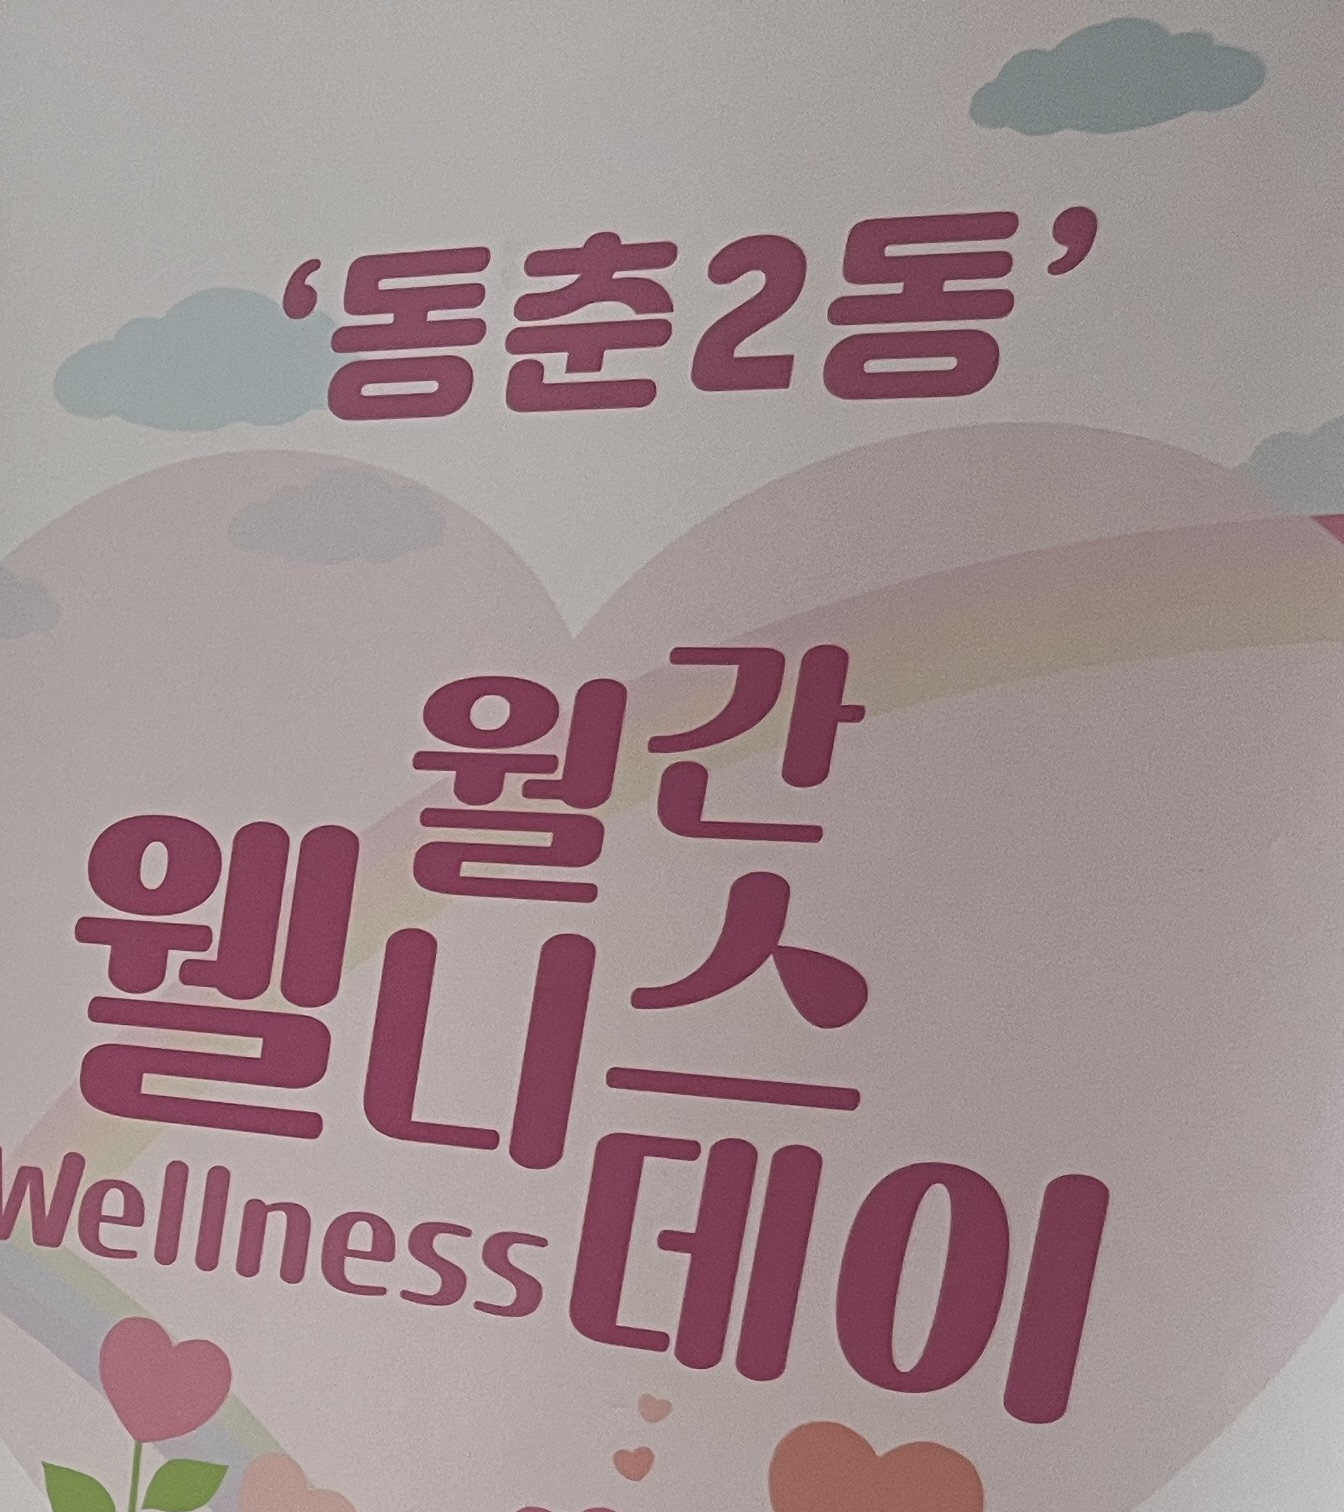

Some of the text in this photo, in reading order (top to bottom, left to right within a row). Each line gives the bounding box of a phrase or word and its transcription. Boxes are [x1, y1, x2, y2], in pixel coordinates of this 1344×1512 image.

[413, 644, 865, 904] 월간
[74, 813, 869, 1170] 웰니스
[569, 1131, 1111, 1425] 데이
